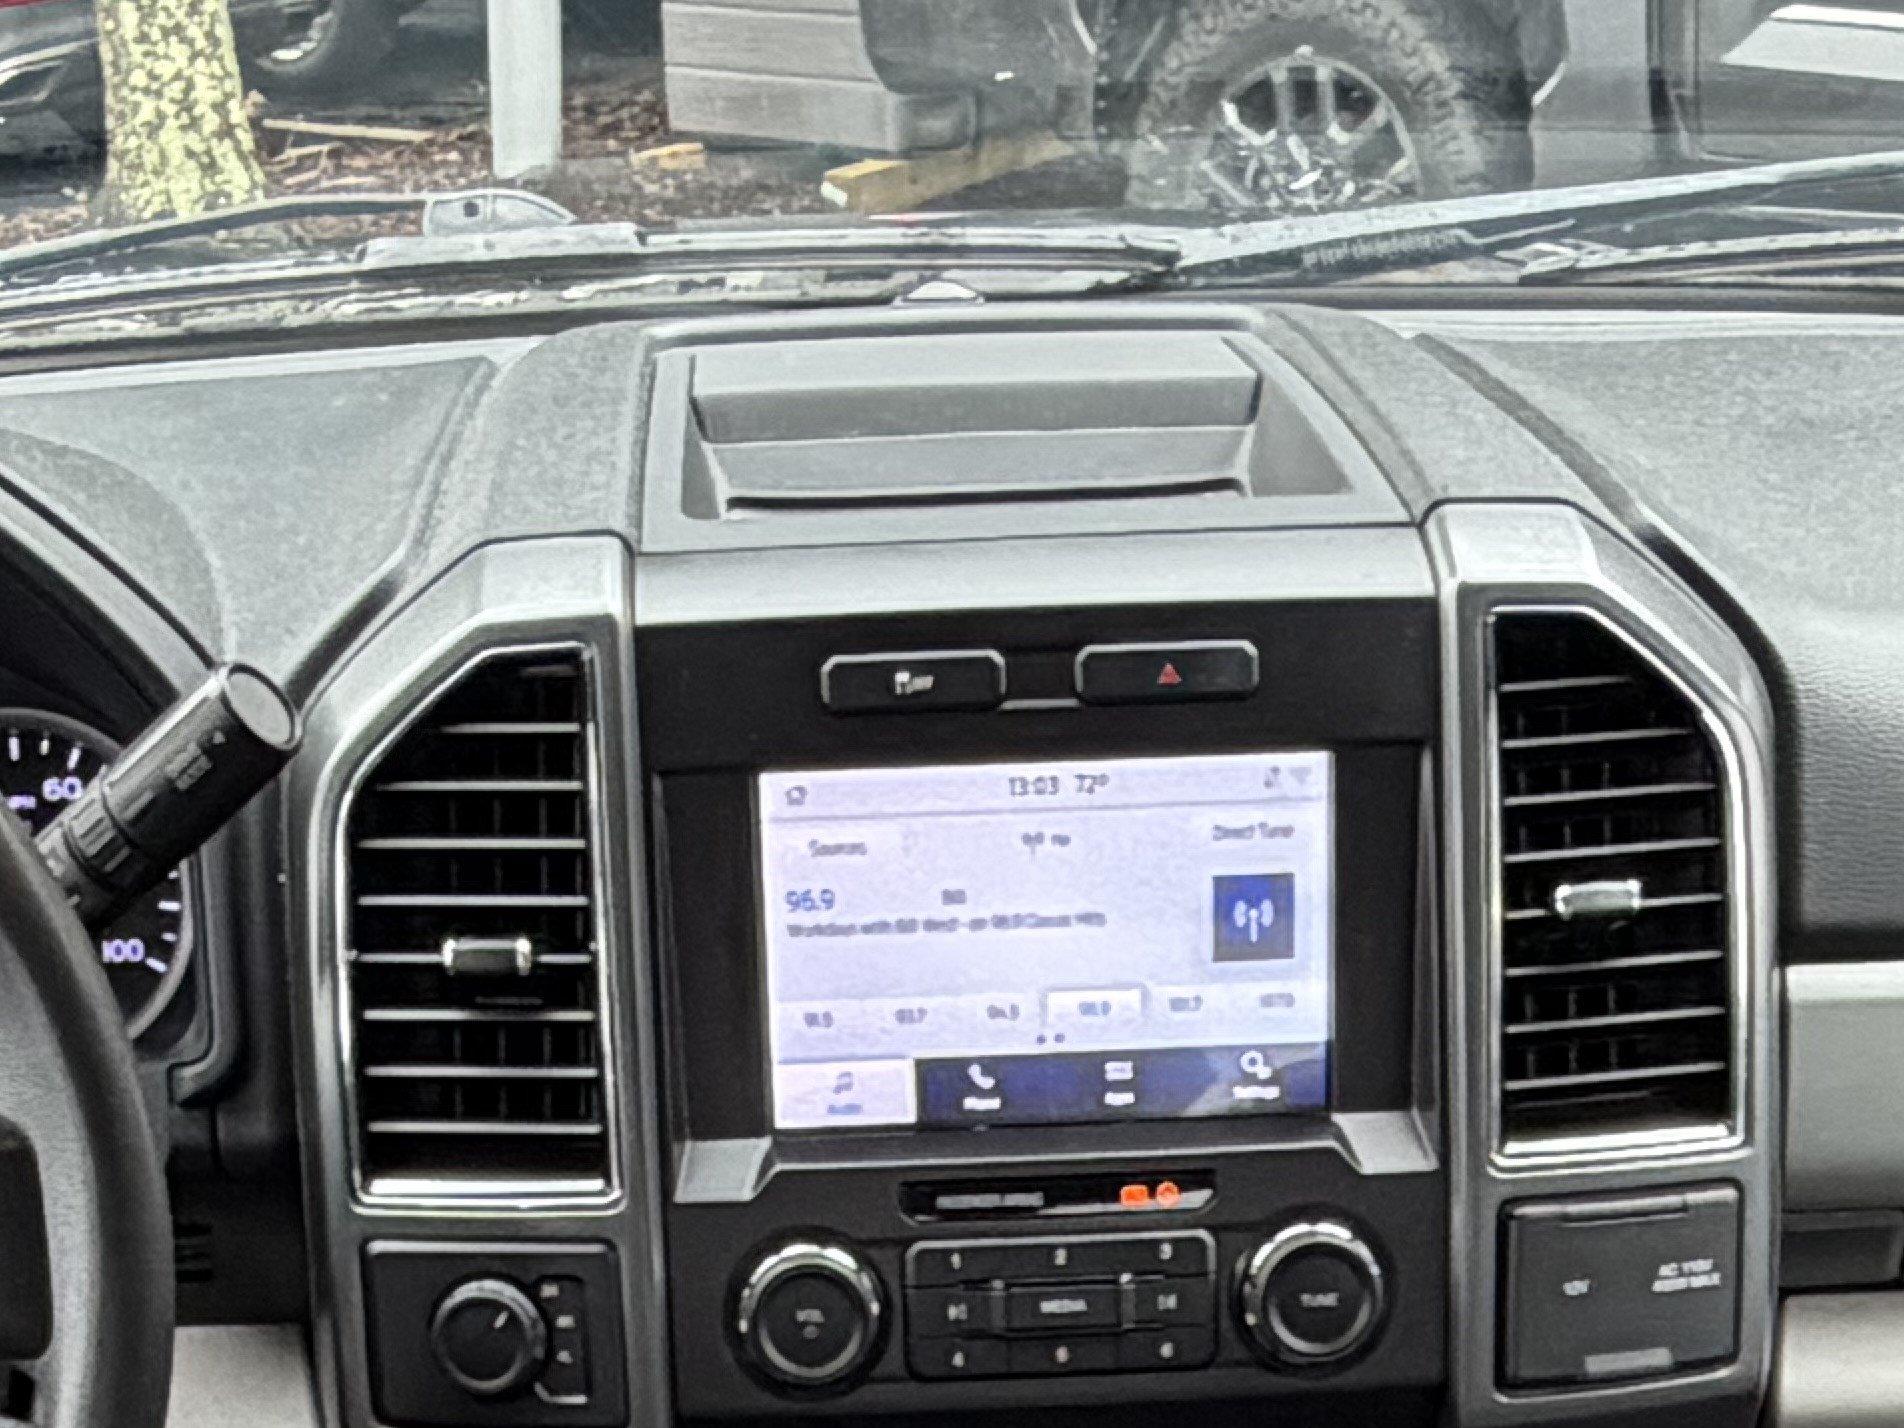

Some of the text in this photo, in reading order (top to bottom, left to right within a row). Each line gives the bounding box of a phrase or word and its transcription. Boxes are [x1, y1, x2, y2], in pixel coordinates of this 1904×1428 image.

[42, 776, 82, 801] 60
[101, 937, 146, 963] 100
[1054, 1248, 1068, 1266] 2
[1159, 1242, 1173, 1260] 3
[951, 1351, 965, 1368] 4
